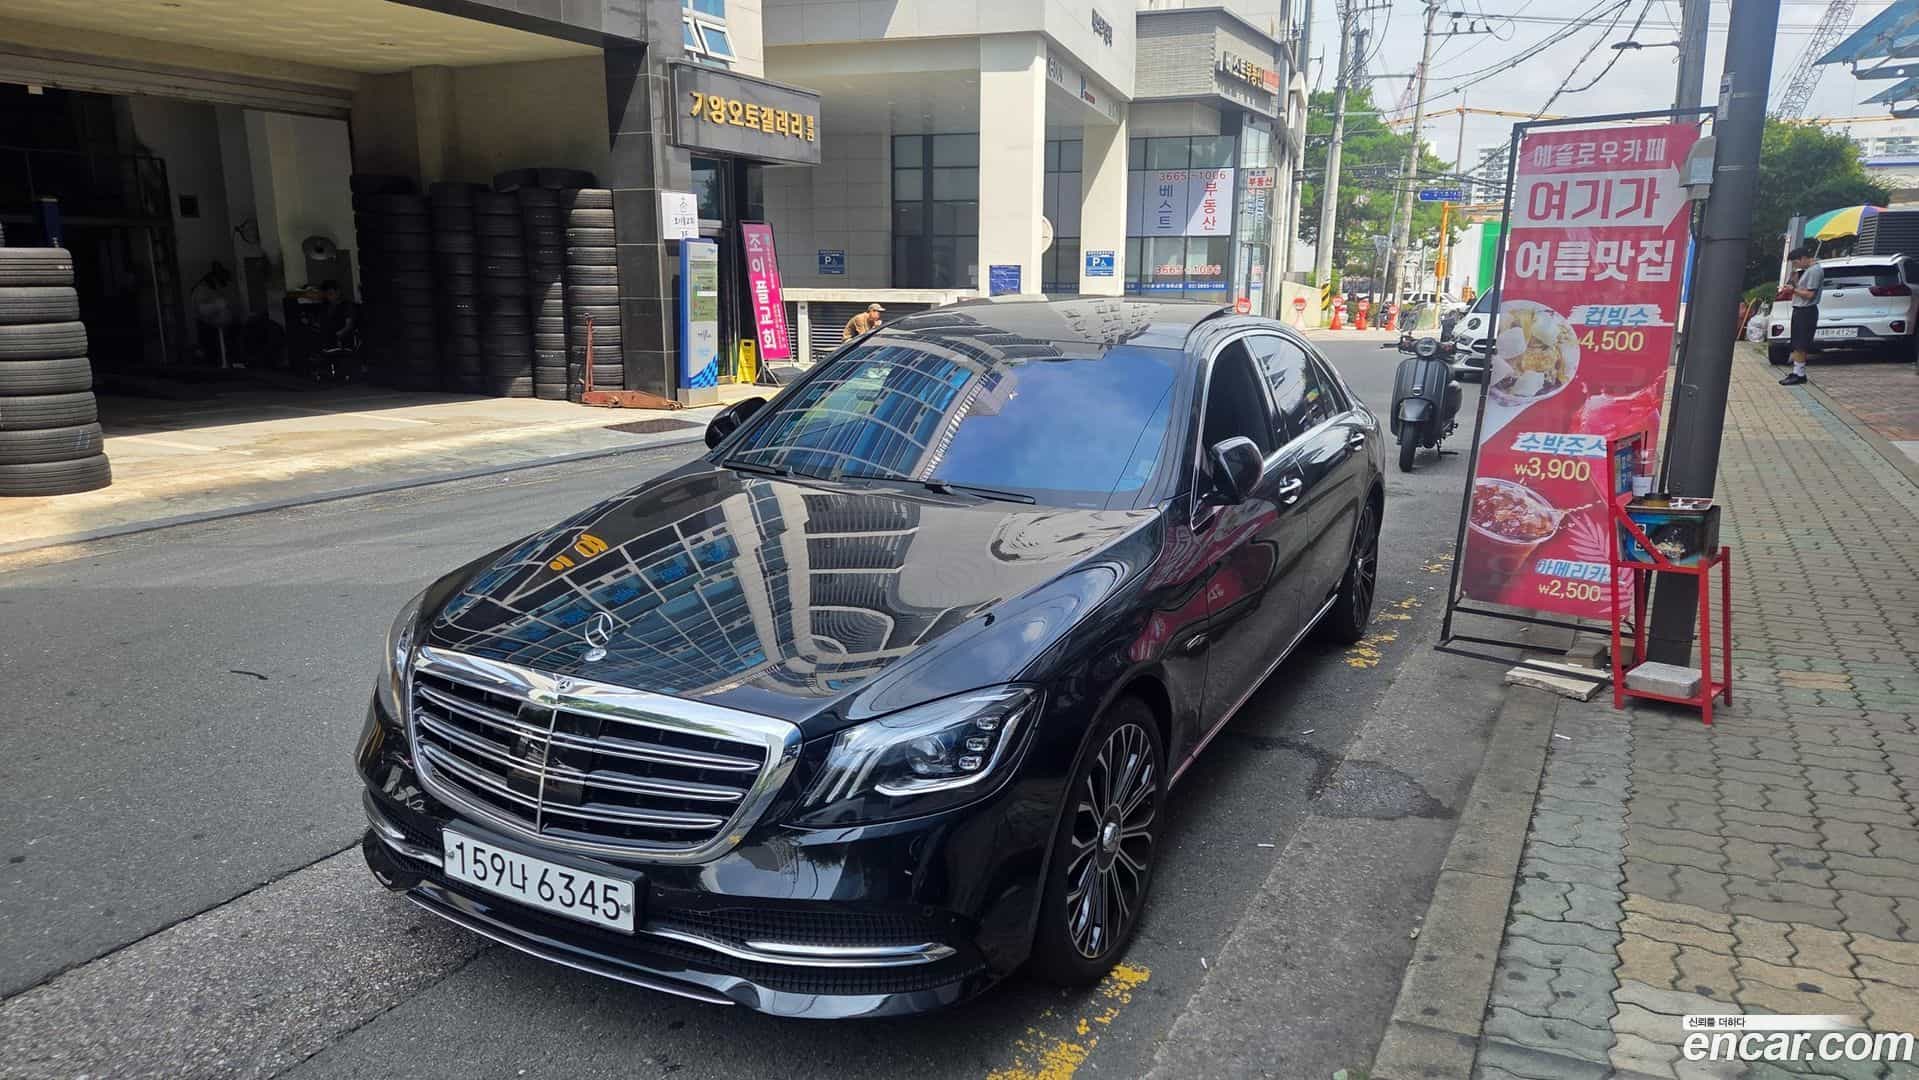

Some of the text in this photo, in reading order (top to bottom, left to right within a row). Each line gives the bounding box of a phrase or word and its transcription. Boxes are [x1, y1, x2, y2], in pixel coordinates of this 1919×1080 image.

[1156, 183, 1174, 229] 베스트
[1202, 181, 1217, 231] 부동산
[1527, 176, 1661, 221] 여기가
[1515, 239, 1676, 282] 여름맛집
[1584, 306, 1649, 328] 컵빙수
[455, 840, 621, 921] 159나 6345
